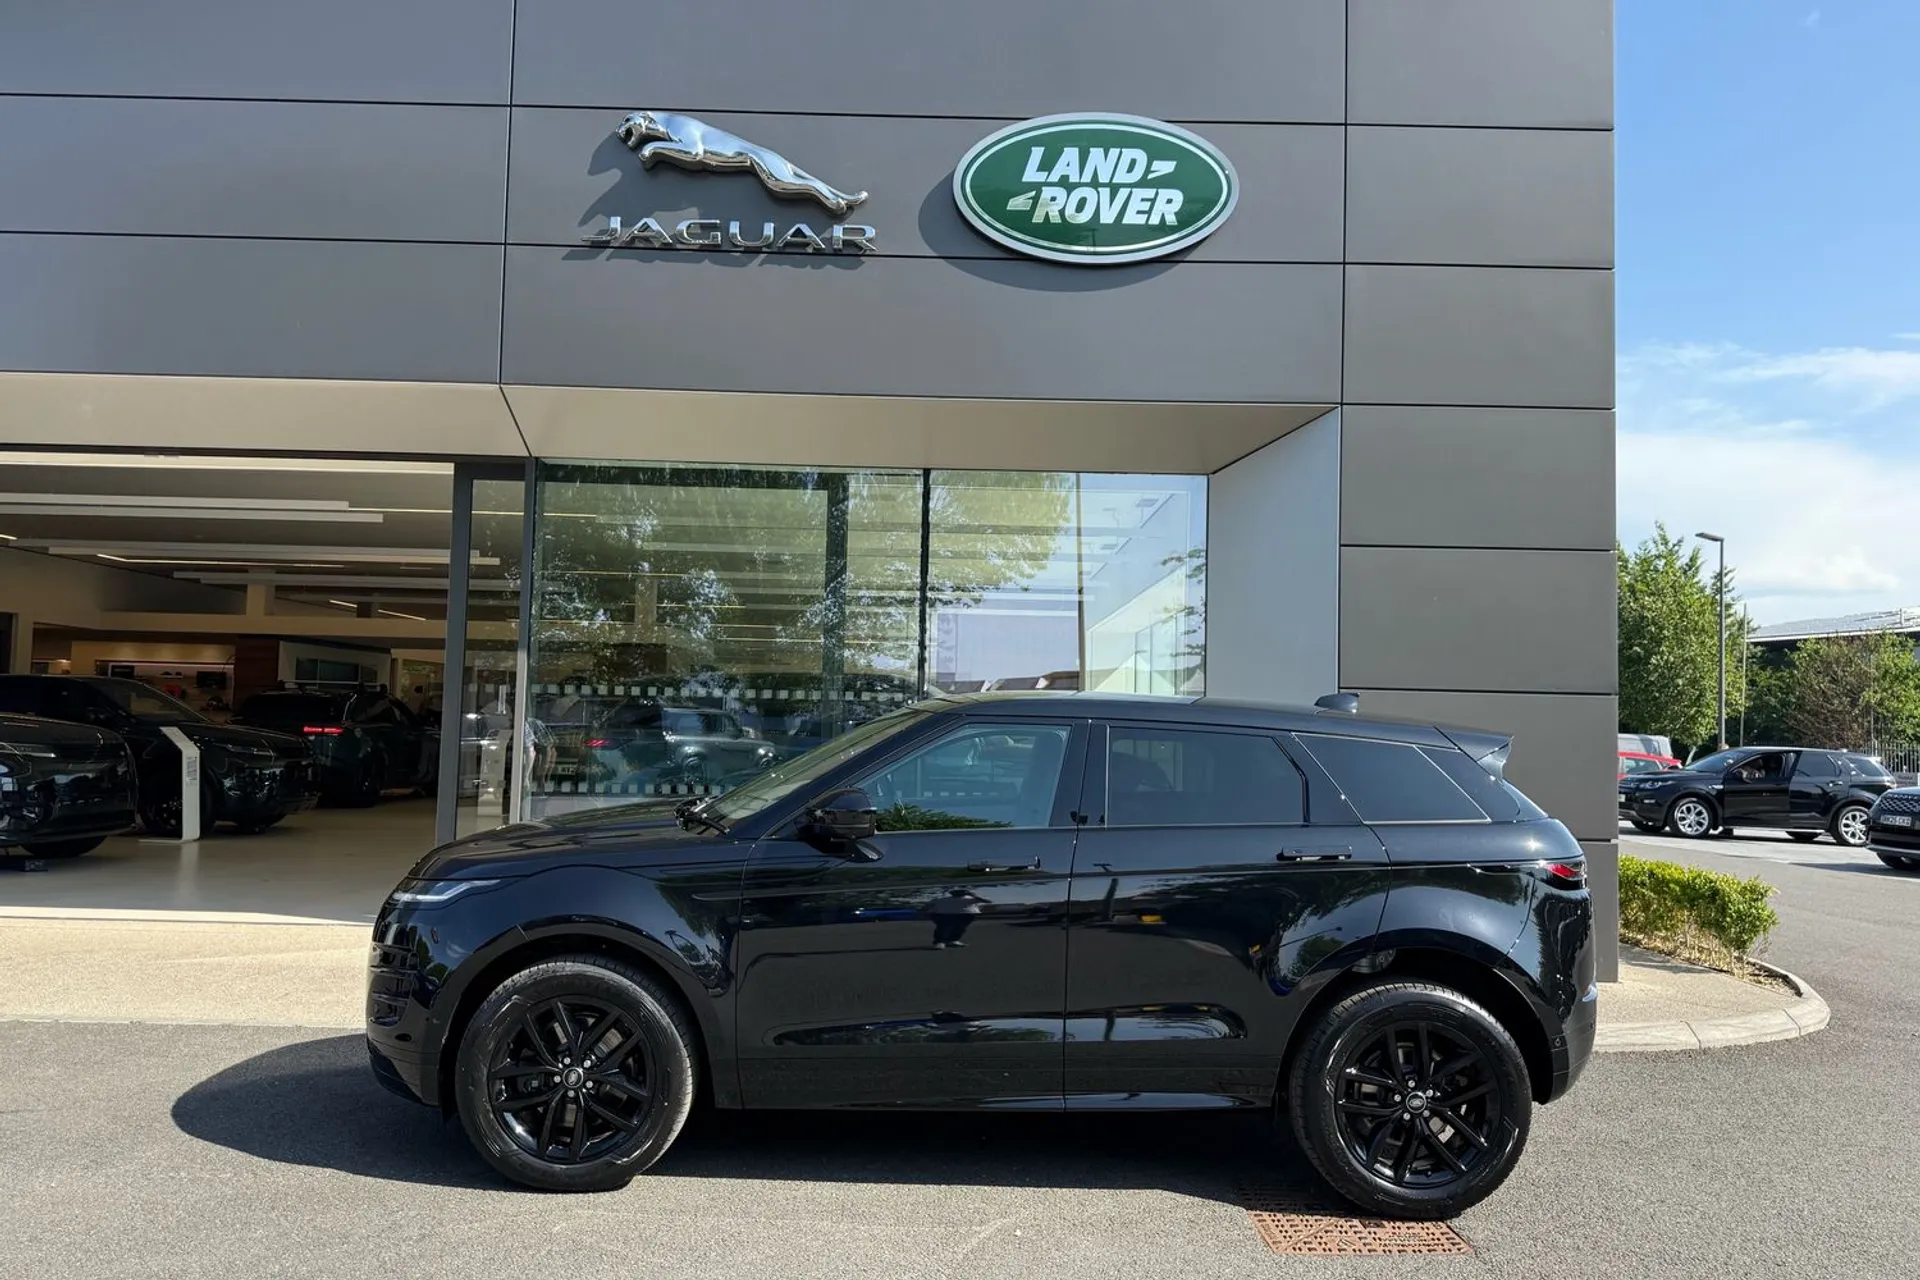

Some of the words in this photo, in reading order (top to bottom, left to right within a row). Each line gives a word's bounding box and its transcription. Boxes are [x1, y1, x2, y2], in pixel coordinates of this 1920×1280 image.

[1022, 147, 1148, 183] LAND
[1032, 187, 1184, 225] ROVER
[582, 216, 876, 251] JAGUAR
